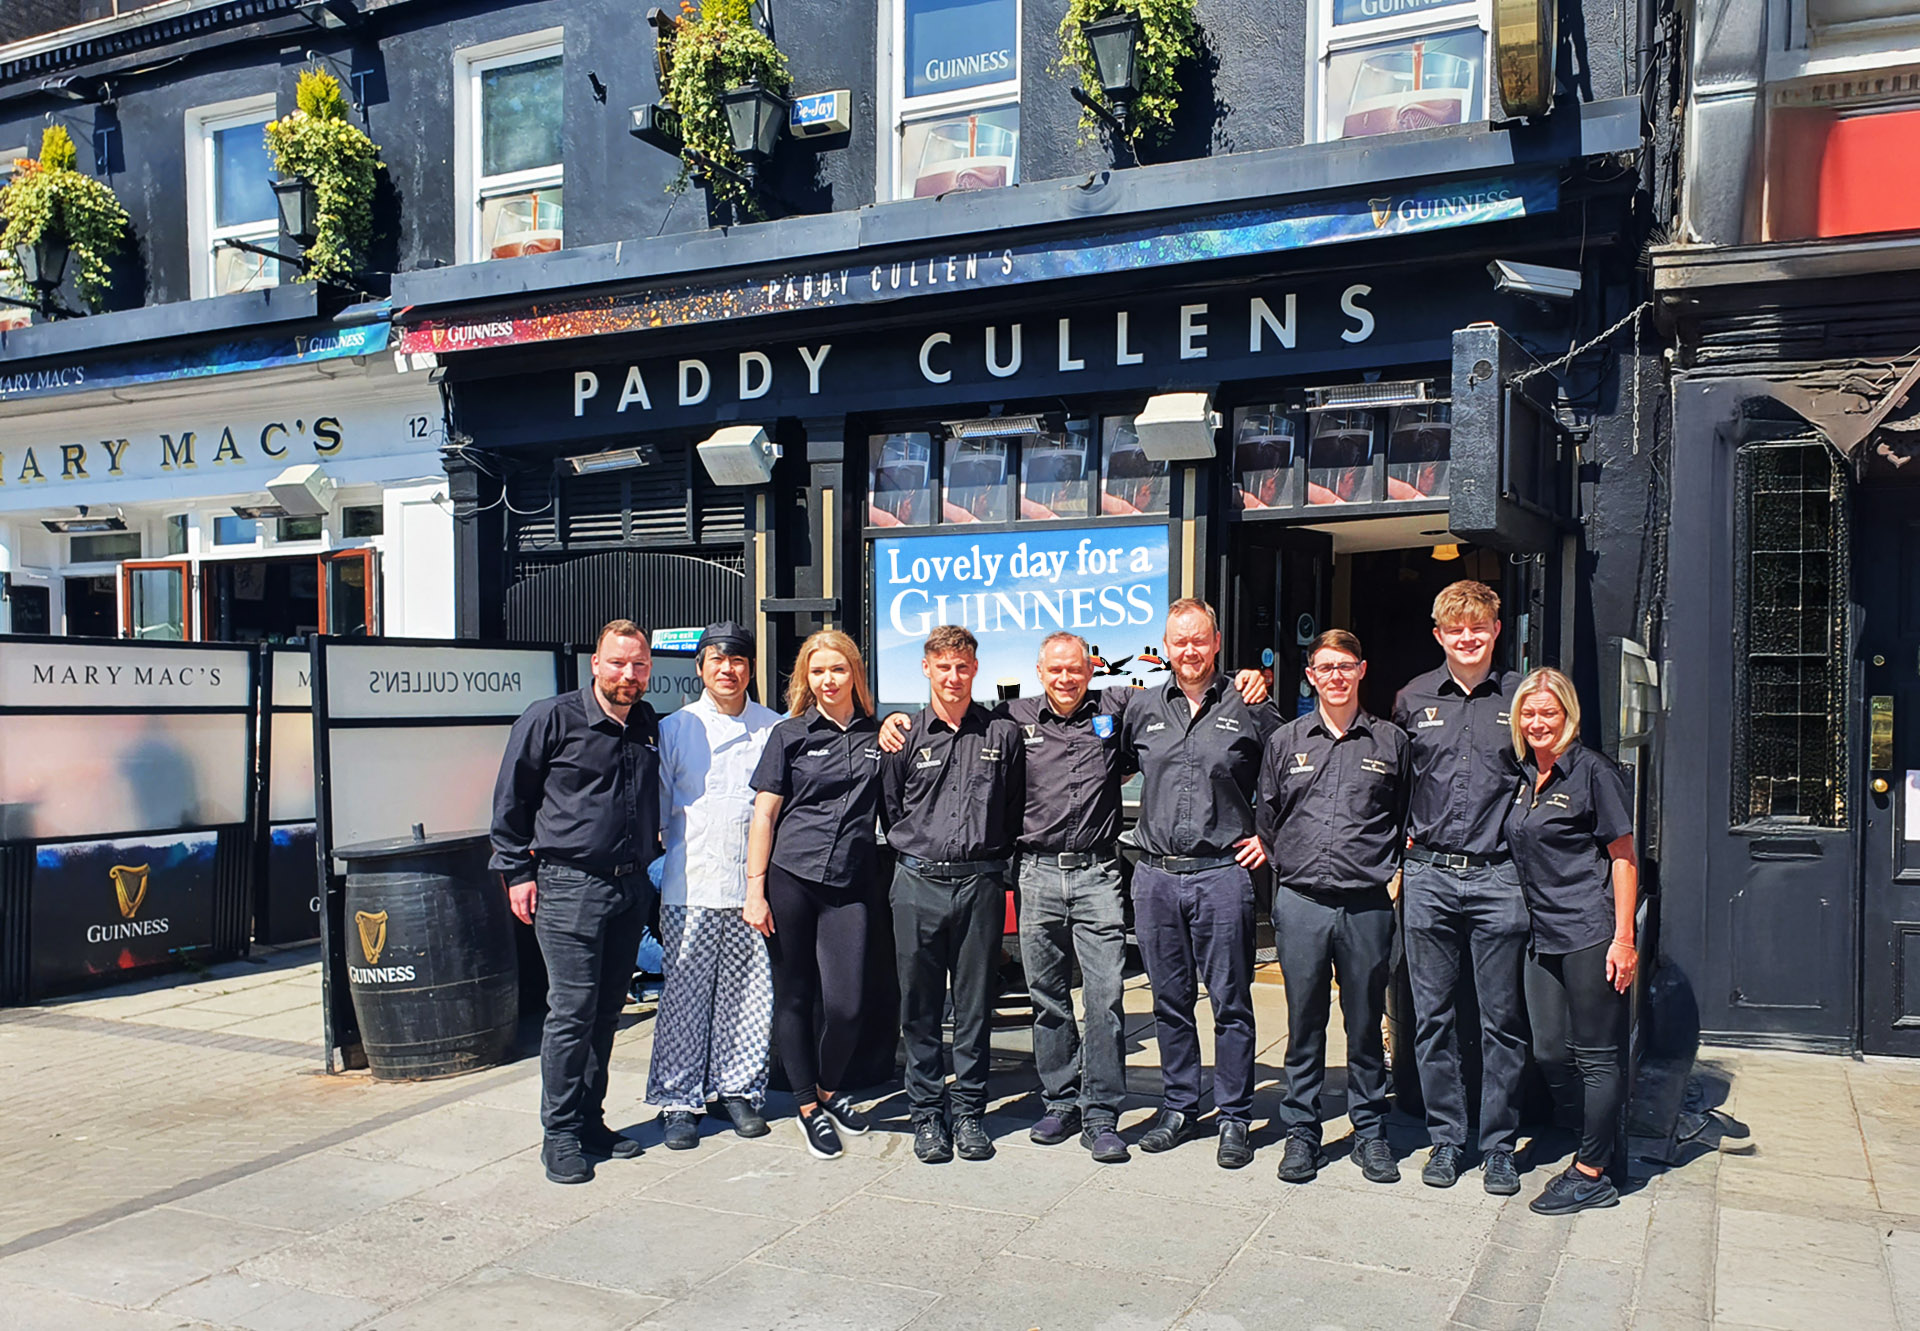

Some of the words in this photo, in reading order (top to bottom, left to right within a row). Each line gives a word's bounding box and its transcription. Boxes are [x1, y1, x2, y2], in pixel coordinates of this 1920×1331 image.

[925, 49, 1009, 83] GUINNESS
[1397, 189, 1511, 222] GUINNESS
[769, 269, 849, 304] PADDY
[871, 248, 1014, 292] CULLEN'S
[309, 332, 366, 354] GUINNESS
[447, 320, 513, 343] GUINNESS
[574, 344, 832, 417] PADDY
[919, 284, 1375, 384] CULLENS
[36, 366, 84, 389] MAC'S
[408, 416, 428, 438] 12
[0, 439, 129, 485] ARY
[160, 416, 344, 471] MAC'S
[888, 544, 1003, 586] Lovely
[1010, 542, 1069, 582] day
[1077, 538, 1123, 575] for
[1129, 546, 1153, 572] a
[889, 584, 1154, 637] GUINNESS
[33, 664, 122, 685] MARY
[134, 667, 222, 686] MAC'S
[87, 918, 170, 944] GUINNESS
[349, 965, 416, 984] GUINNESS
